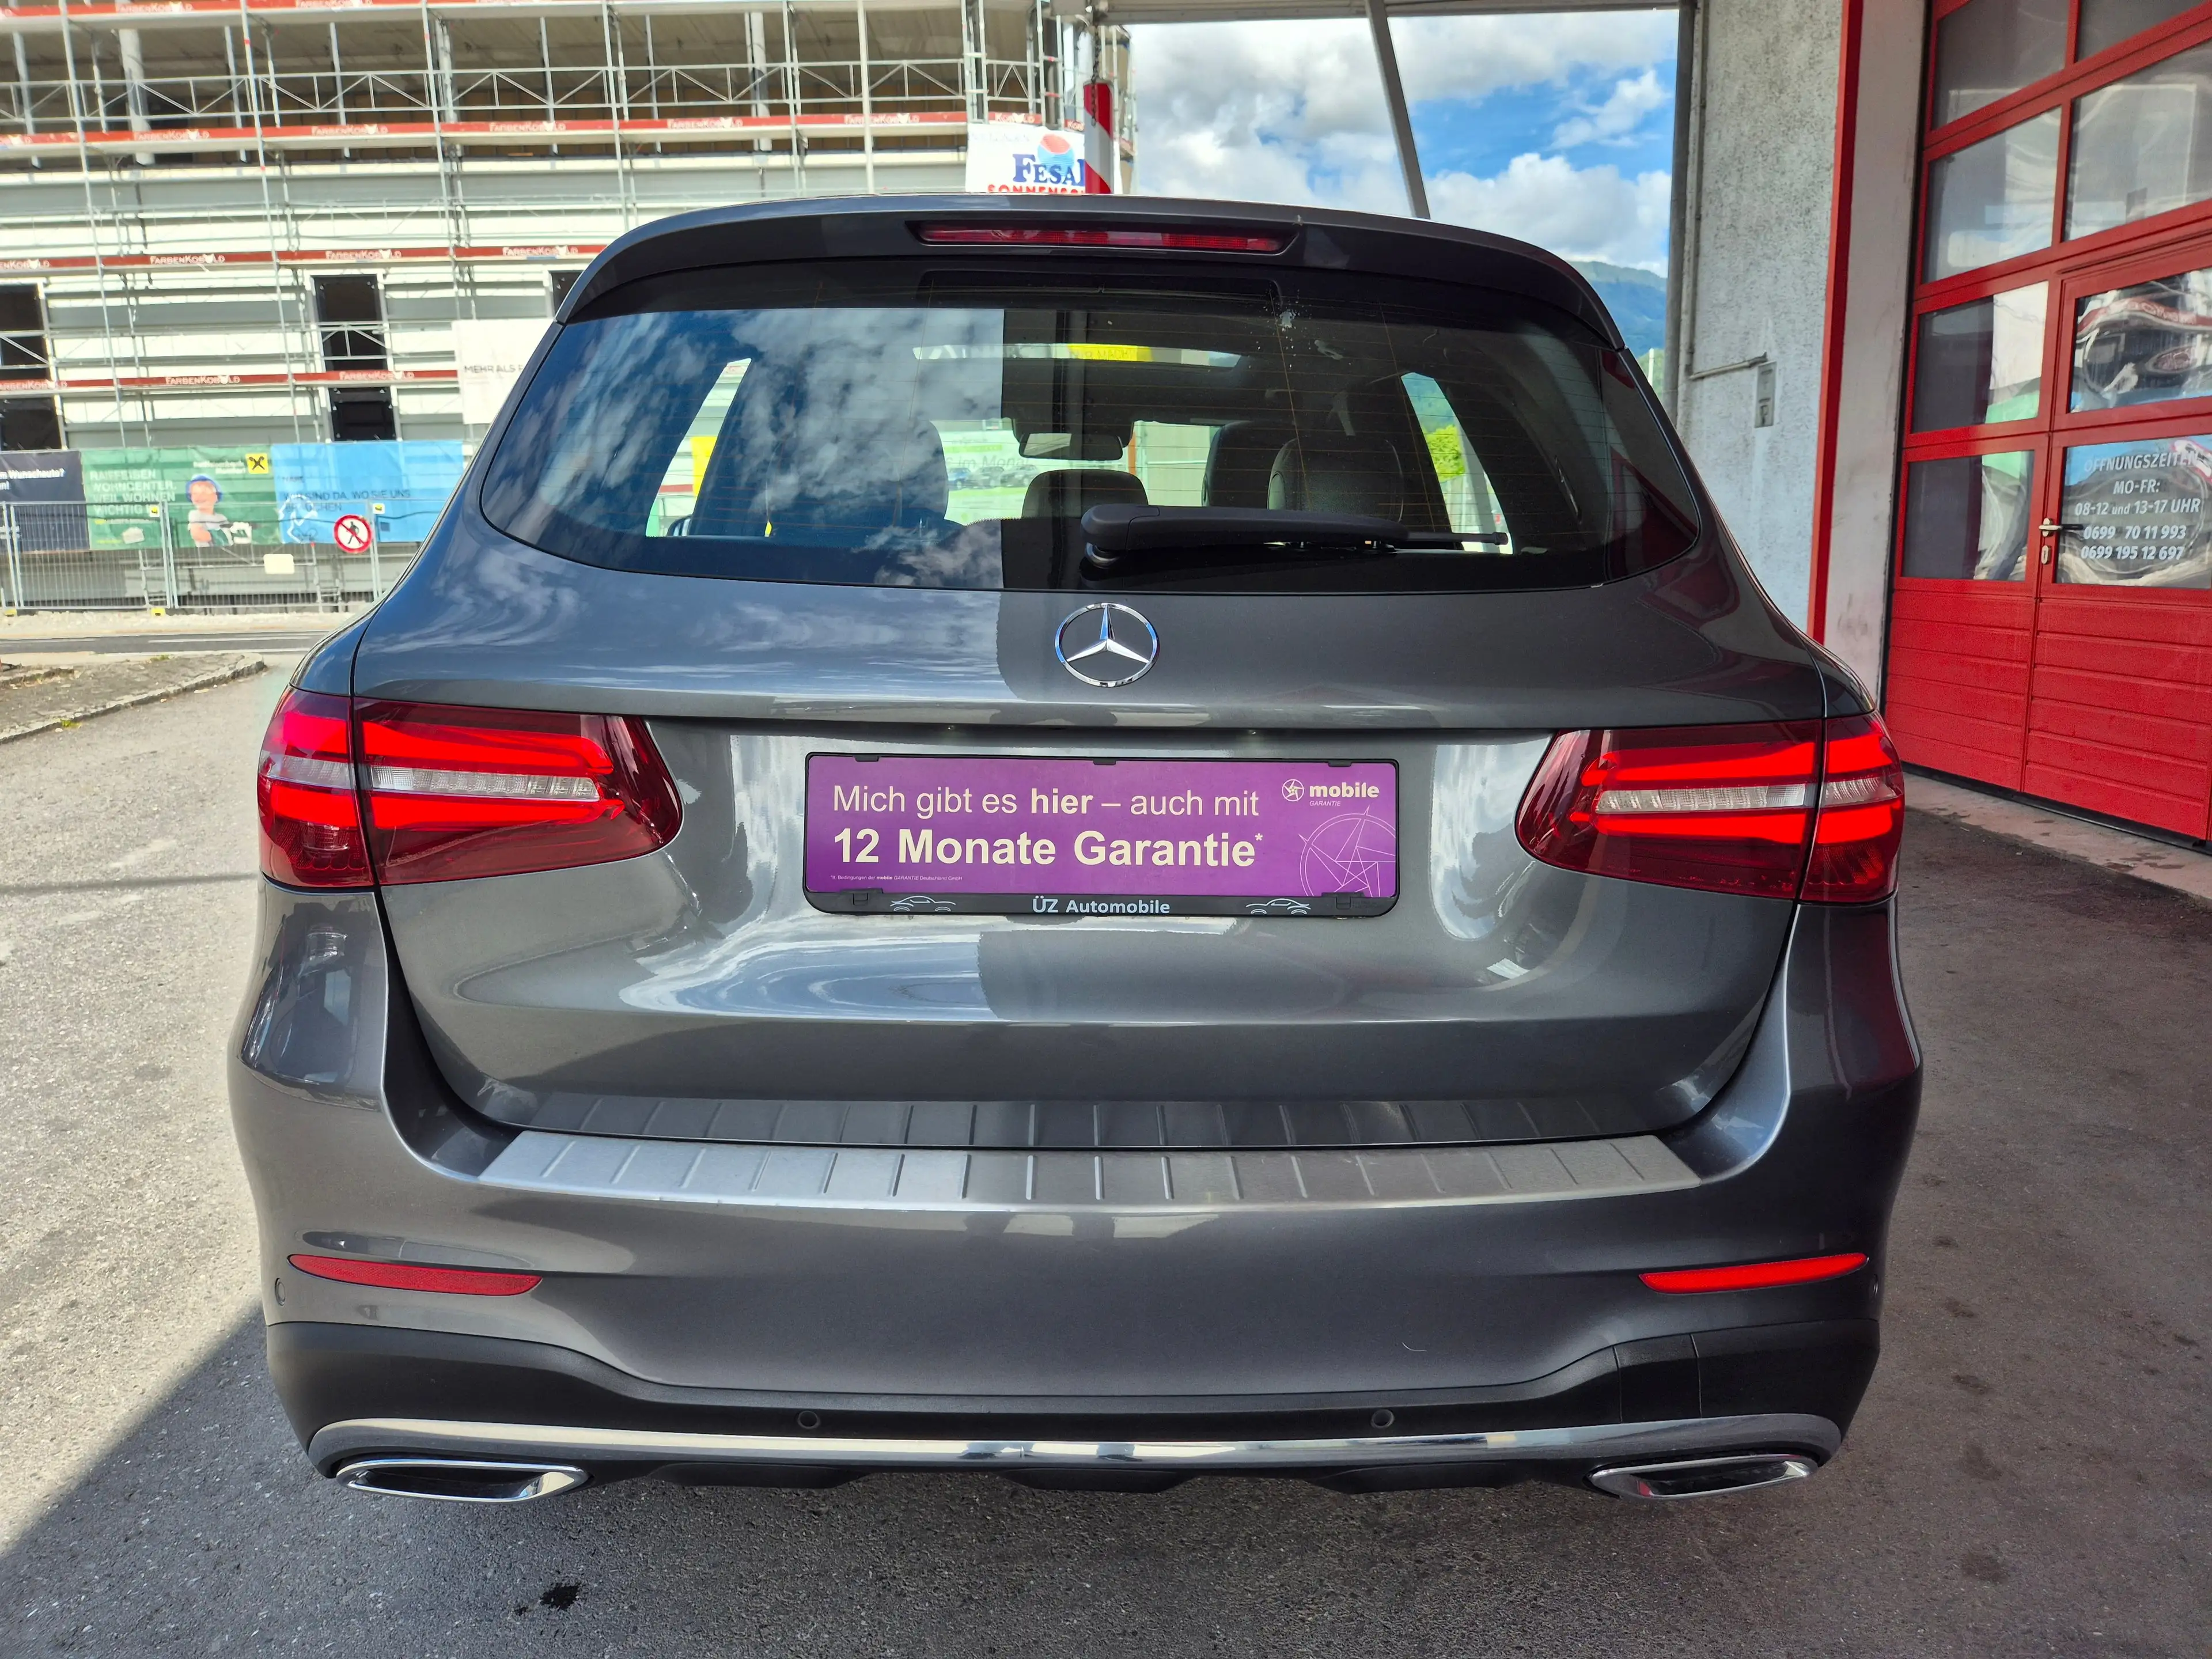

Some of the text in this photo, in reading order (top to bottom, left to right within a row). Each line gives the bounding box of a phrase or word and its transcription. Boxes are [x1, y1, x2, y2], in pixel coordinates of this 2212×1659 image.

[464, 365, 494, 374] MEHR
[497, 364, 516, 373] ALS
[89, 469, 156, 480] RAIFFEISEN
[2113, 479, 2161, 494] MO-FR:
[92, 491, 176, 503] WEIL WOHNEN
[94, 505, 143, 516] WICHTIG
[2074, 498, 2201, 516] 08-12 und 13-17 UHR
[2083, 525, 2187, 540] 0699 70 11 993
[2081, 546, 2185, 560] 0699 195 12 697
[1309, 782, 1380, 798] mobile
[834, 785, 905, 812] Mich
[916, 786, 972, 819] gibt
[982, 793, 1017, 814] es
[1031, 788, 1093, 815] hier
[1130, 790, 1203, 816] auch
[1214, 790, 1259, 816] mit
[835, 828, 879, 863] 12
[899, 829, 1056, 865] Monate
[1033, 895, 1171, 914] ÜZ Automobile
